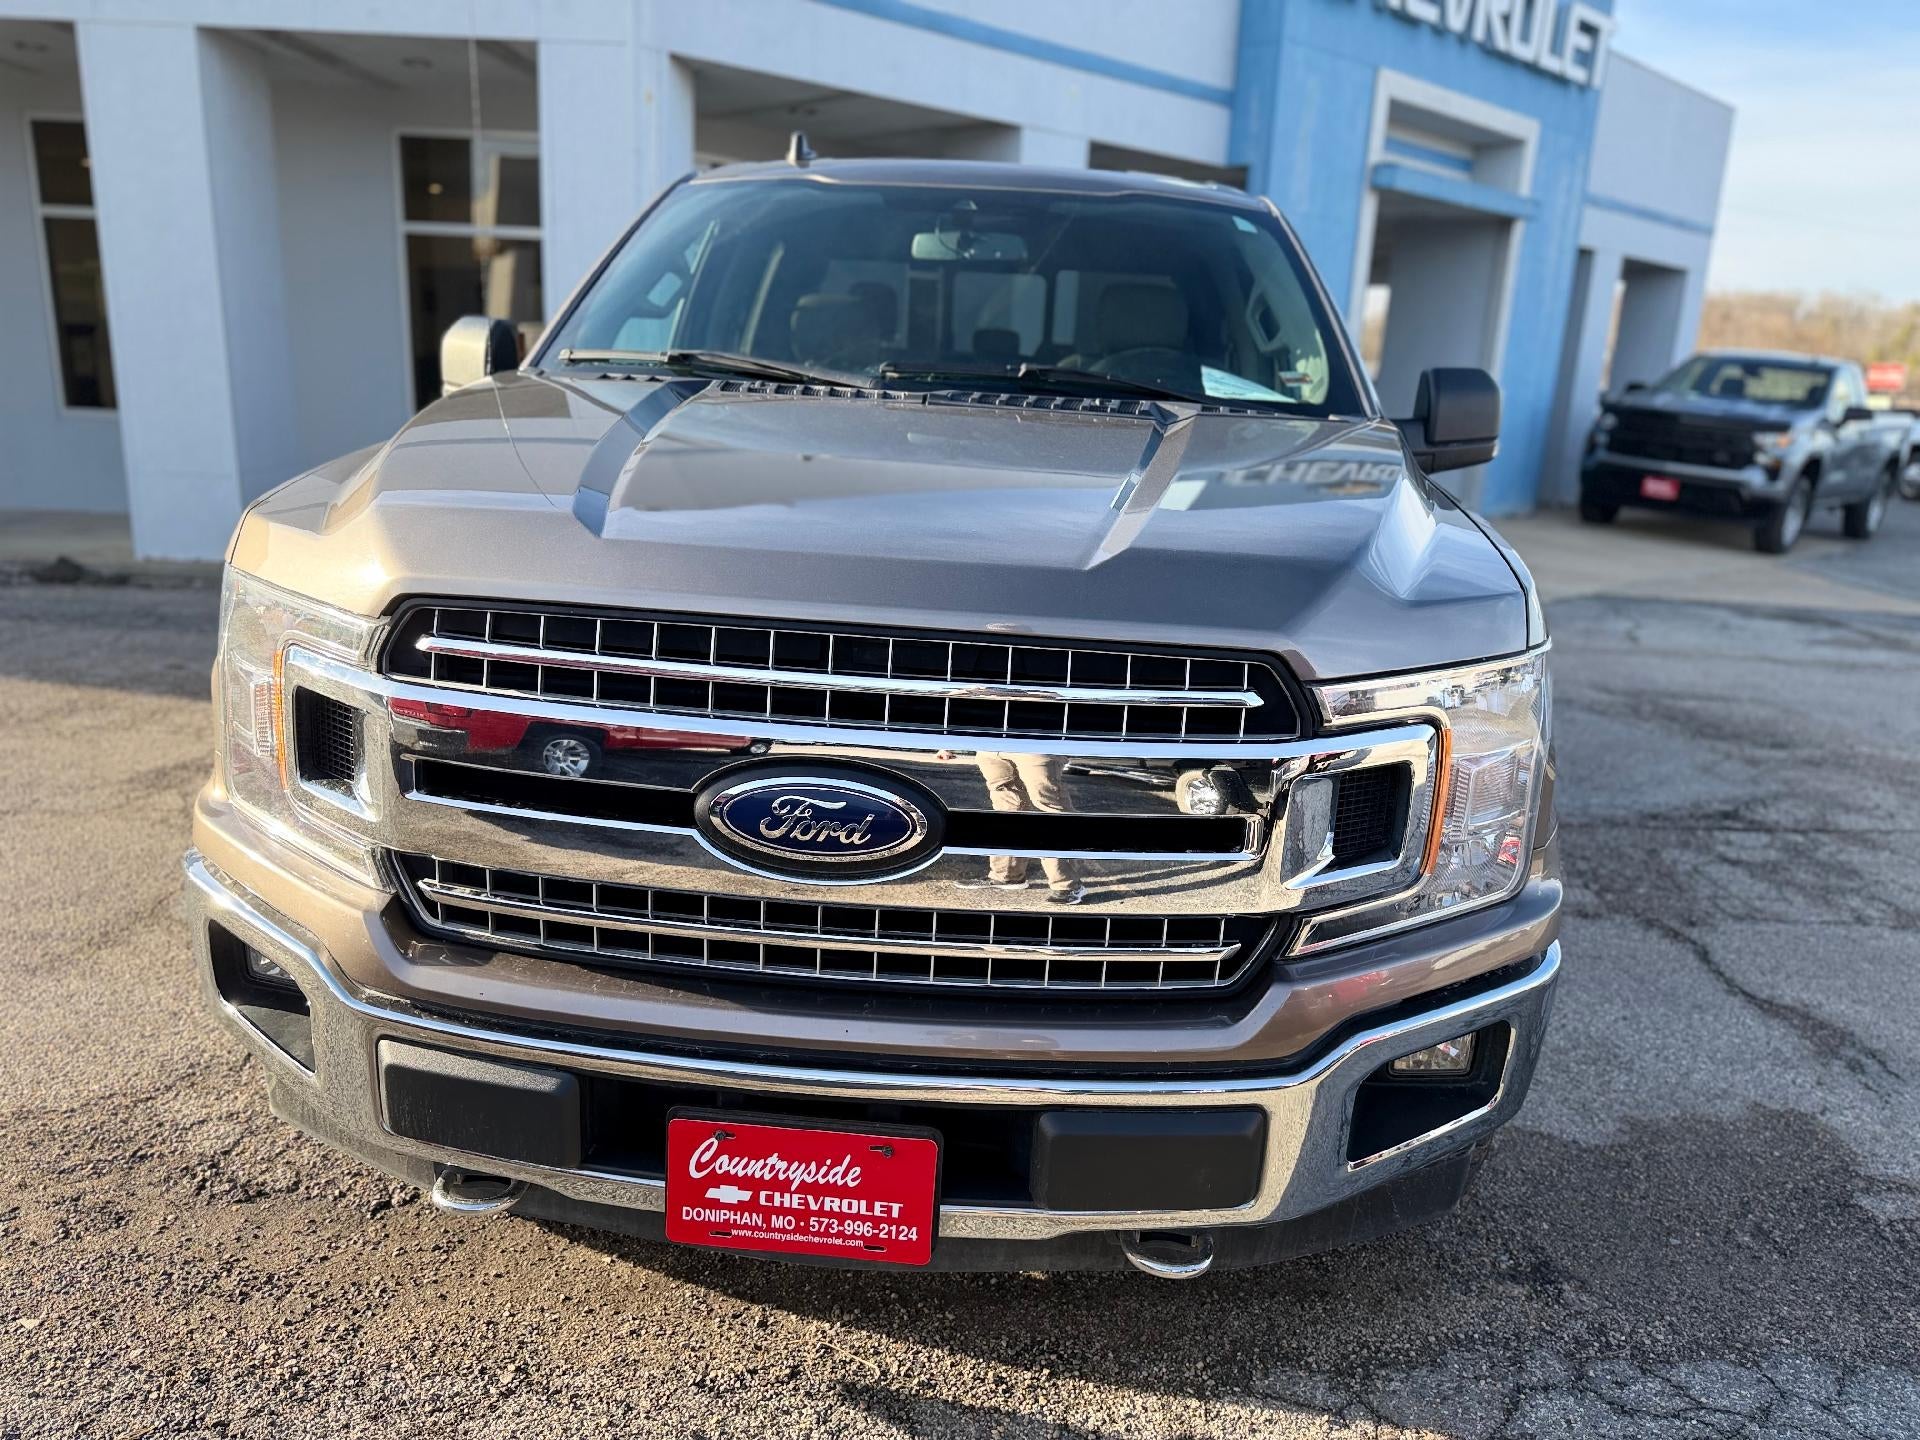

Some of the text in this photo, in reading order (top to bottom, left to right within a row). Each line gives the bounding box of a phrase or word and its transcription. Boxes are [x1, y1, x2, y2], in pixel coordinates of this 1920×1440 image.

[1386, 0, 1617, 89] ROLET
[759, 795, 875, 845] Ford
[688, 1137, 862, 1191] Countryside
[682, 1206, 918, 1242] DONIPHAN, MO 573-996-2124
[759, 1190, 904, 1219] CHEVROLET
[731, 1228, 864, 1248] www.countrysidechevrolet.com
